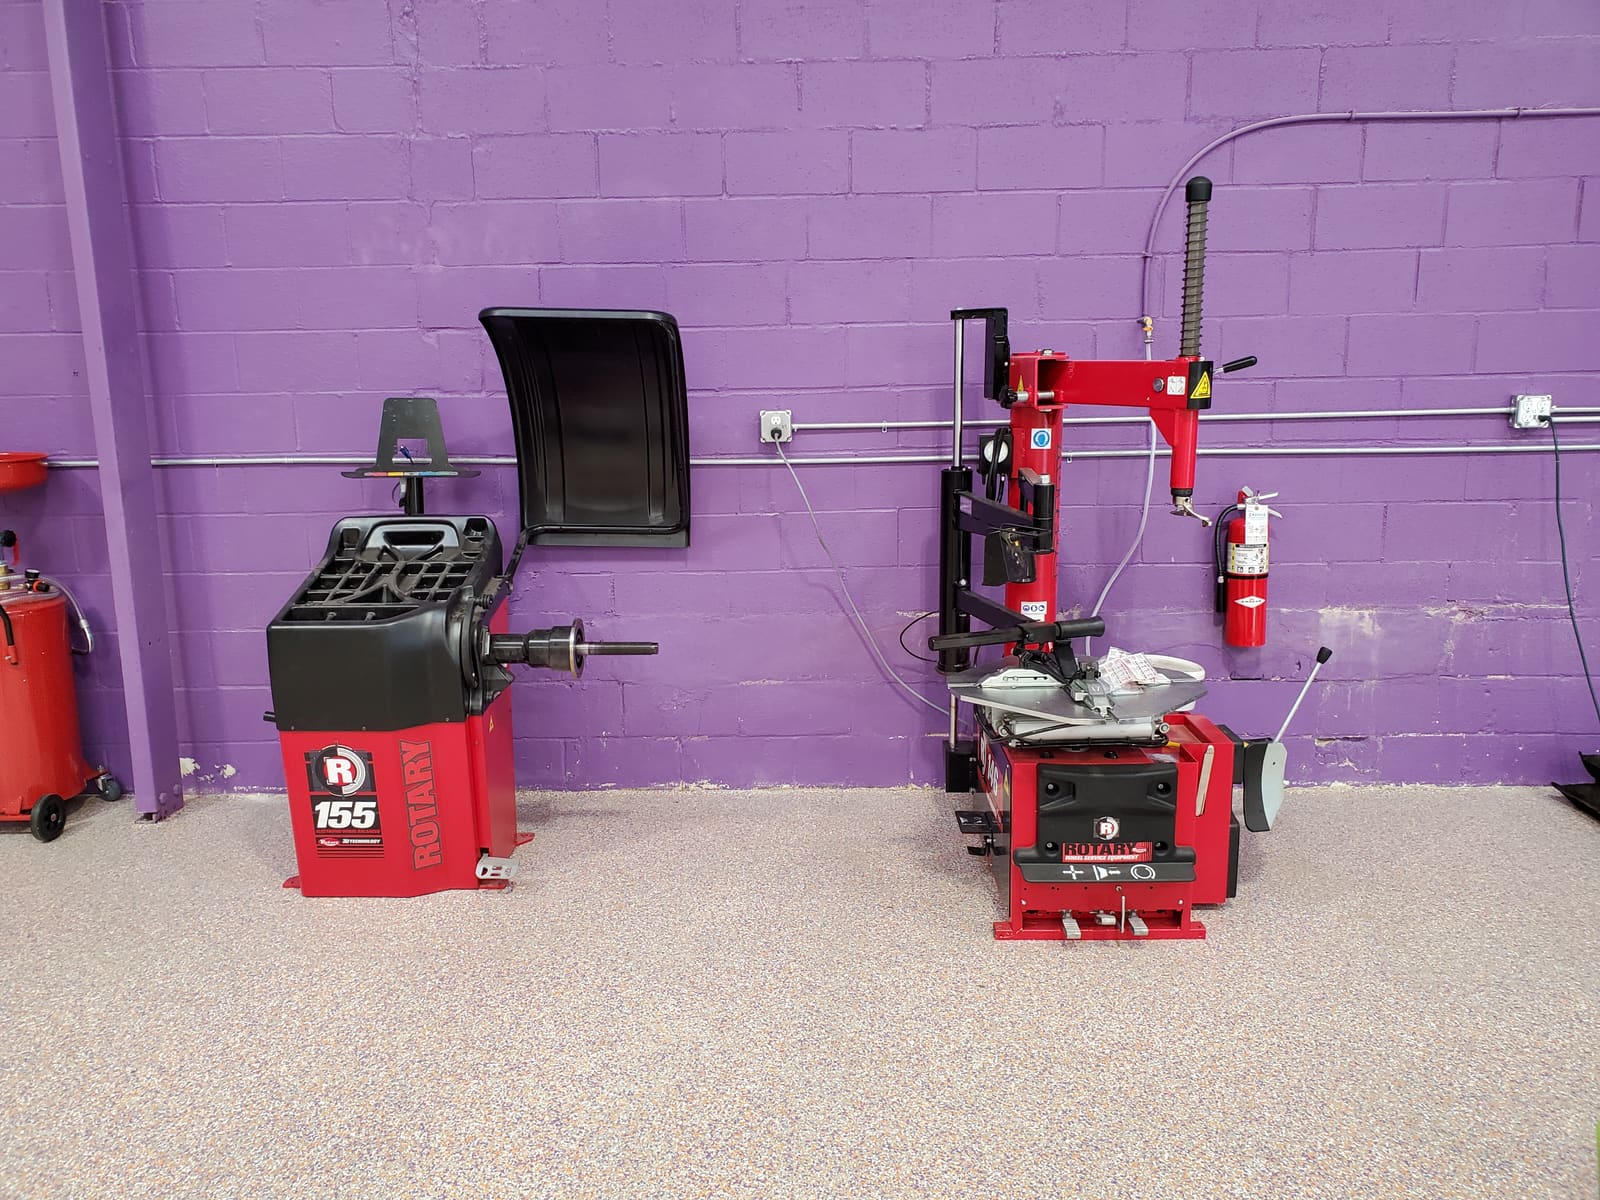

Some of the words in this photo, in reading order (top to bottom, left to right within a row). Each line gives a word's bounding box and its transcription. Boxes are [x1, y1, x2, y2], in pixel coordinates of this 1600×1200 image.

[326, 758, 353, 783] R
[314, 801, 377, 829] 155
[400, 740, 443, 871] ROTARY
[1100, 823, 1113, 835] R
[1065, 842, 1135, 855] ROTARY
